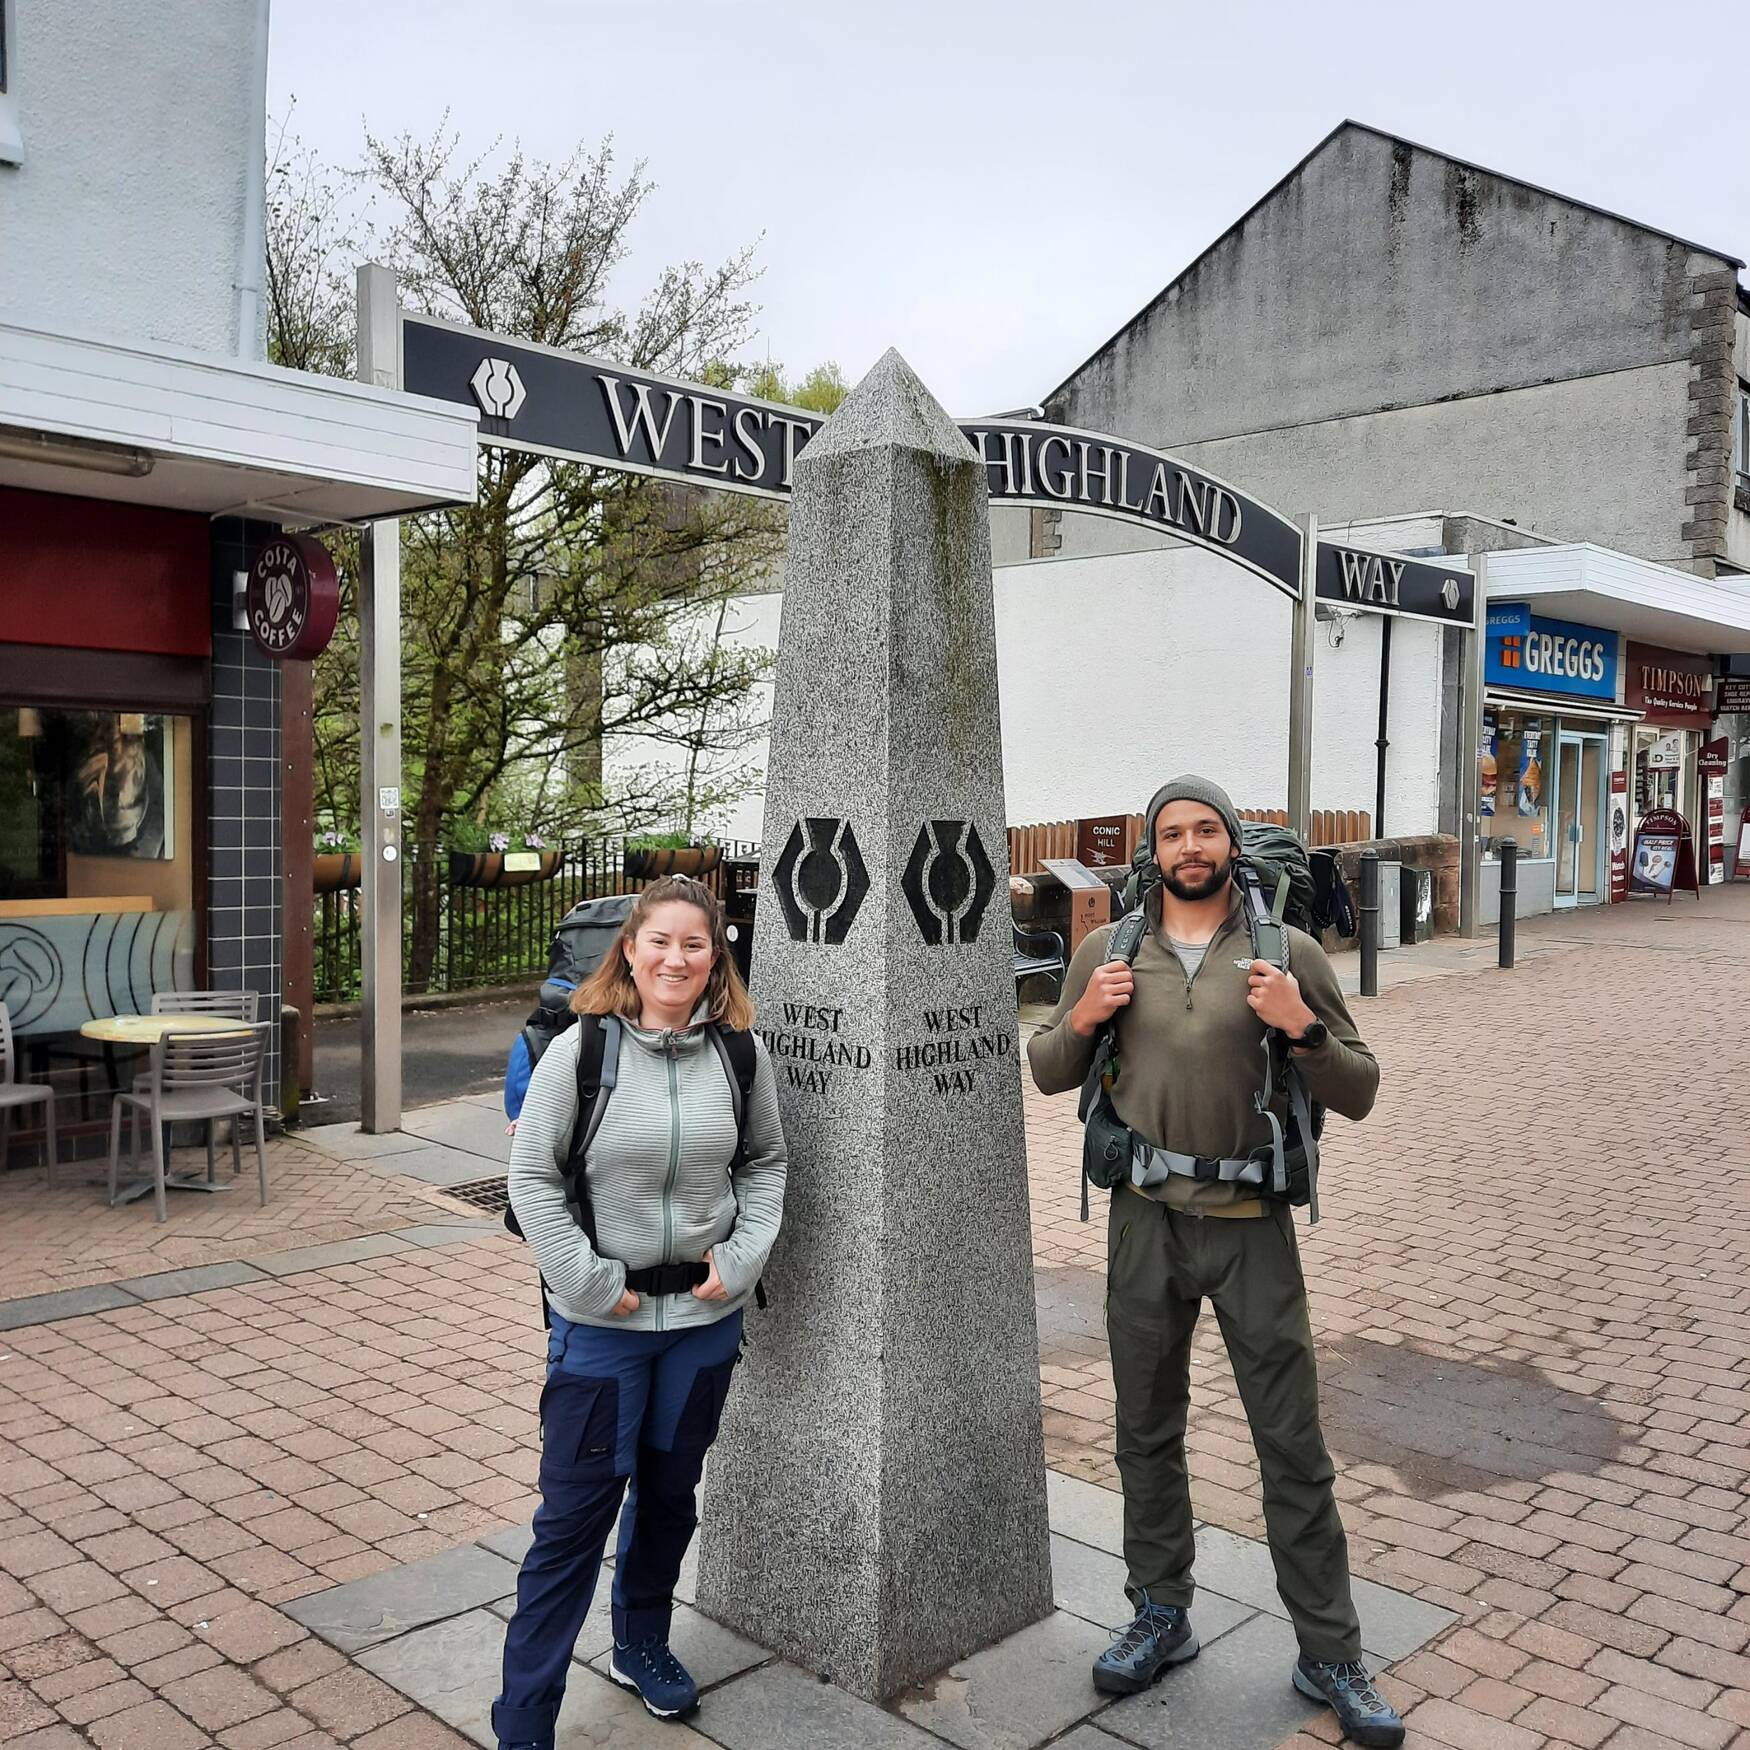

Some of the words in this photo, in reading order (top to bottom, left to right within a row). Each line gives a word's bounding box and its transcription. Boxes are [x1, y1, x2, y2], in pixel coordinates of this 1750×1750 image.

[595, 374, 812, 488] WEST
[973, 431, 1243, 545] HIGHLAND
[1337, 550, 1407, 606] WAY
[257, 546, 298, 577] COSTA
[254, 608, 302, 647] COFFEE
[1525, 631, 1604, 682] GREGGS
[1642, 665, 1702, 697] TIMPSON
[1698, 759, 1727, 767] Cleaning
[1706, 752, 1719, 760] Dry
[1092, 826, 1121, 835] CONIC
[1645, 814, 1678, 826] TIMPSON
[1097, 838, 1115, 847] HILL
[783, 1003, 843, 1032] WEST
[924, 1006, 981, 1033] WEST
[897, 1033, 1011, 1070] HIGHLAND
[787, 1066, 832, 1094] WAY
[934, 1068, 977, 1096] WAY
